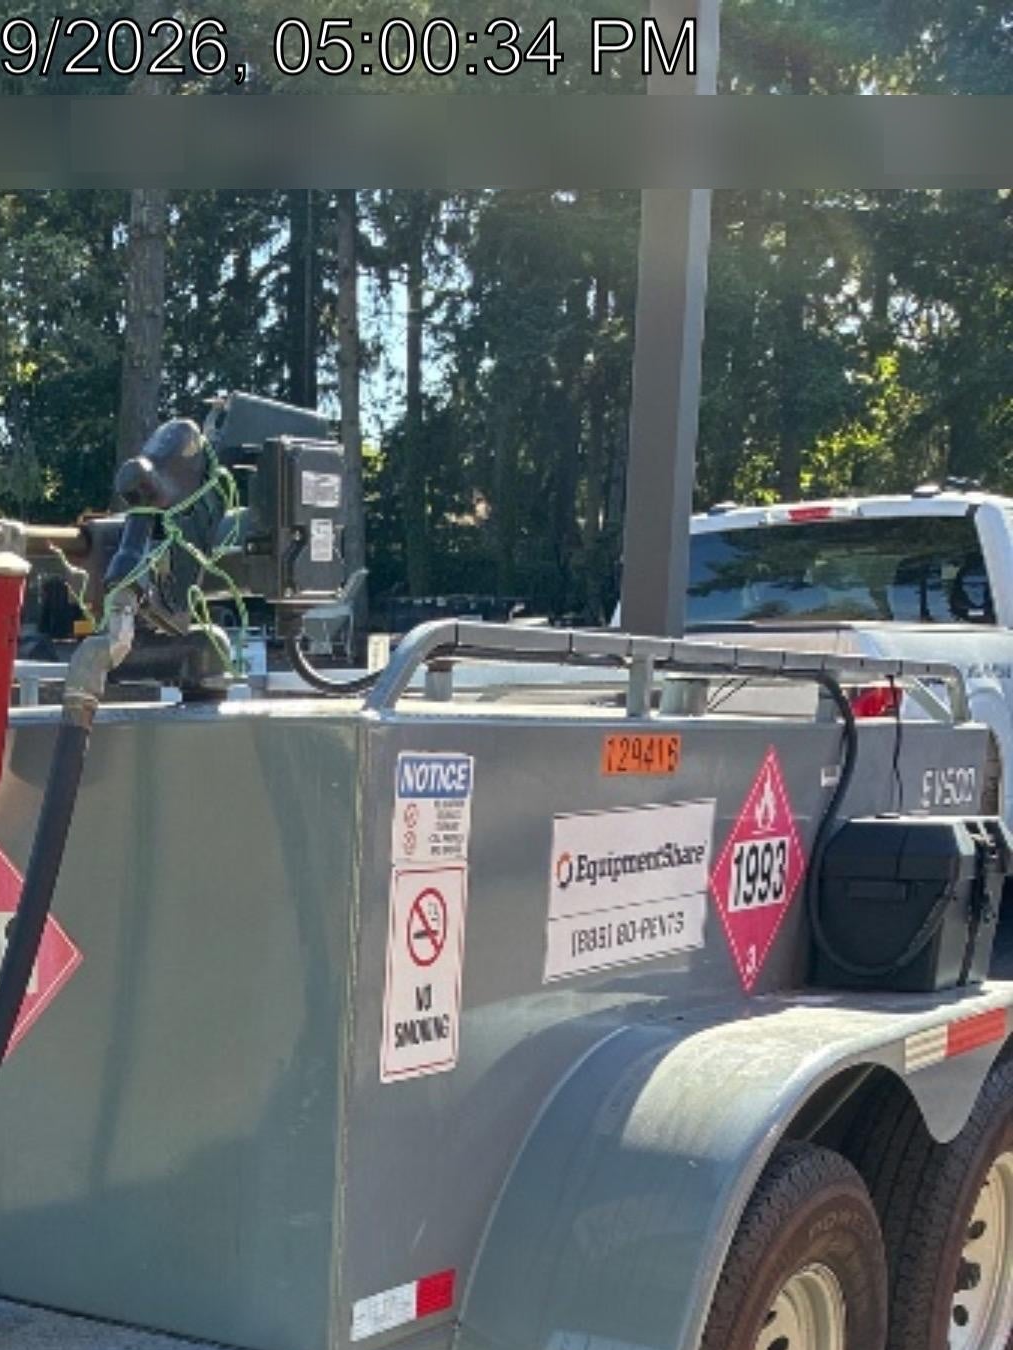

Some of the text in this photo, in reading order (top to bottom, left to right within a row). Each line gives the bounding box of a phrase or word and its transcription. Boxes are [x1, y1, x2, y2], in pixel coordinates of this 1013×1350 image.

[607, 737, 678, 772] 129416
[400, 763, 468, 793] NOTICE
[575, 843, 705, 885] EquipmentShare
[732, 841, 787, 907] 1993
[415, 984, 432, 1011] NO
[395, 1013, 449, 1049] SMOKING
